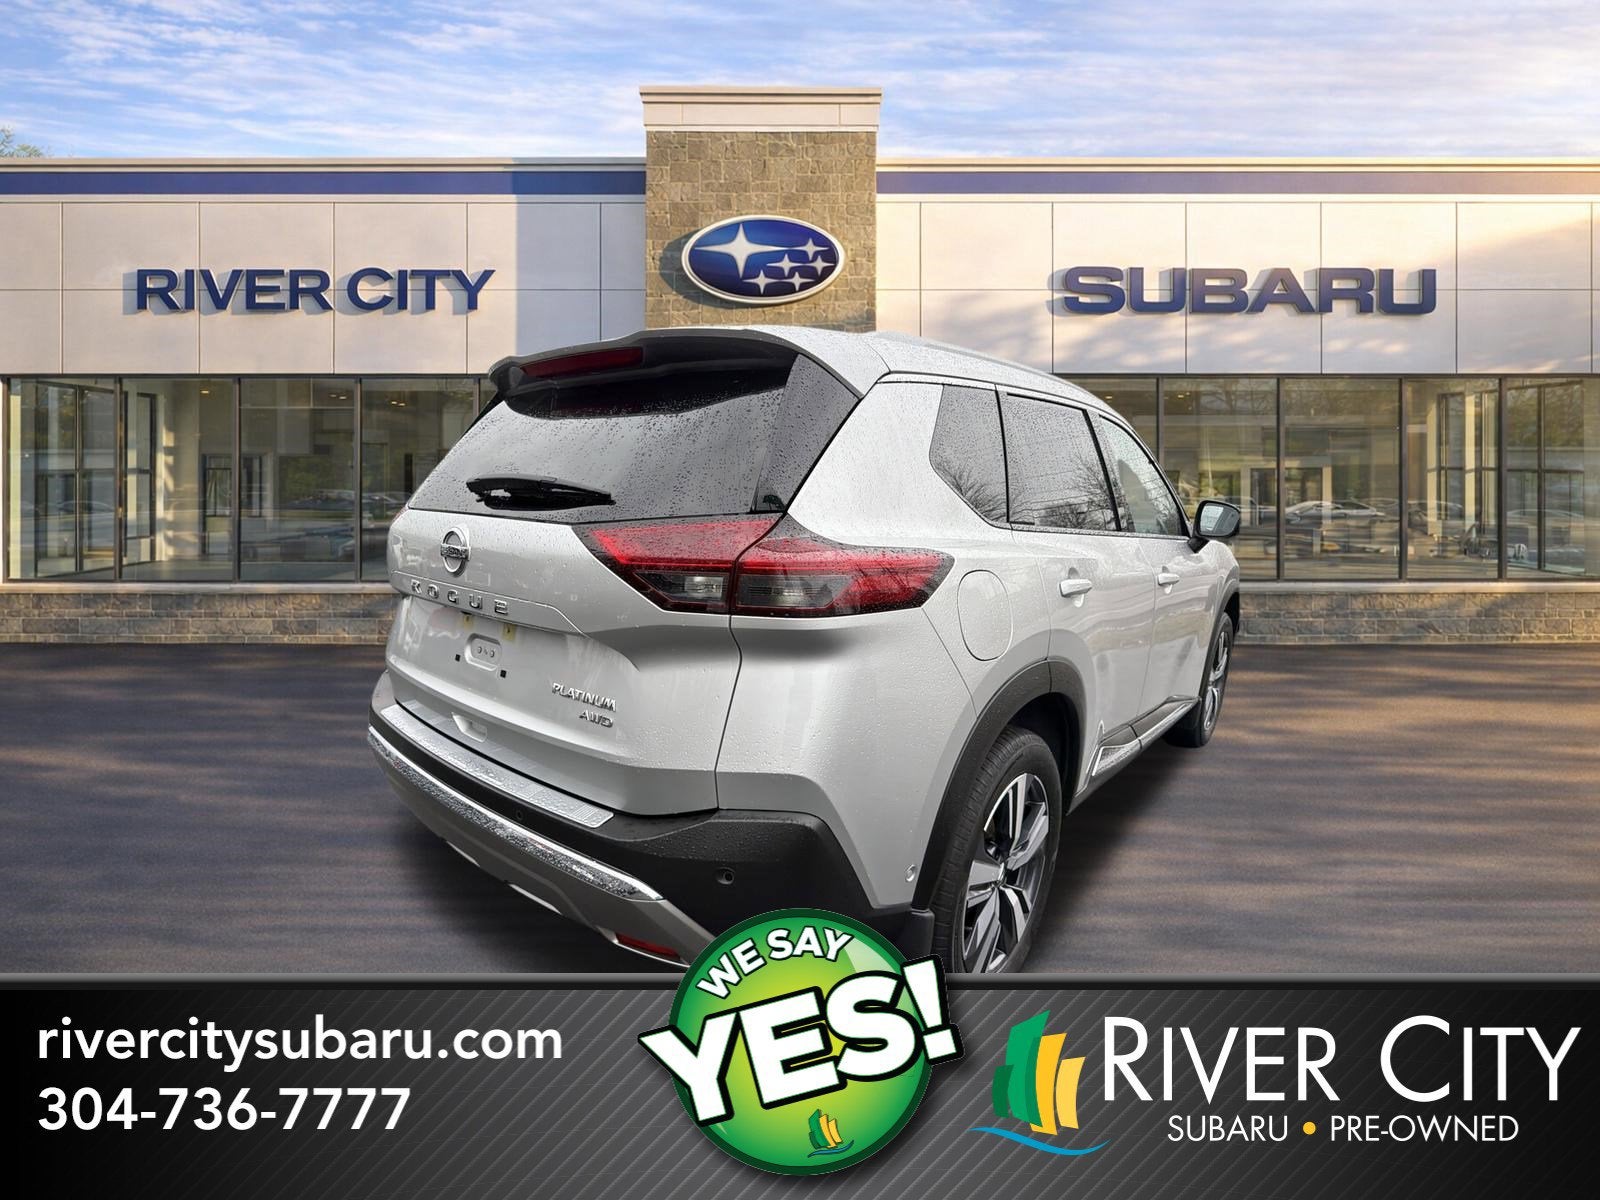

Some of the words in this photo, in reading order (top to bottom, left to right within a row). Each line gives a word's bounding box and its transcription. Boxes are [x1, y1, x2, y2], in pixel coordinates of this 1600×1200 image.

[136, 268, 334, 312] RIVER
[345, 267, 496, 312] CITY
[1063, 266, 1437, 315] SUBARU
[411, 579, 508, 614] ROGUE
[552, 682, 616, 712] PLATINUM
[579, 709, 614, 729] AWD
